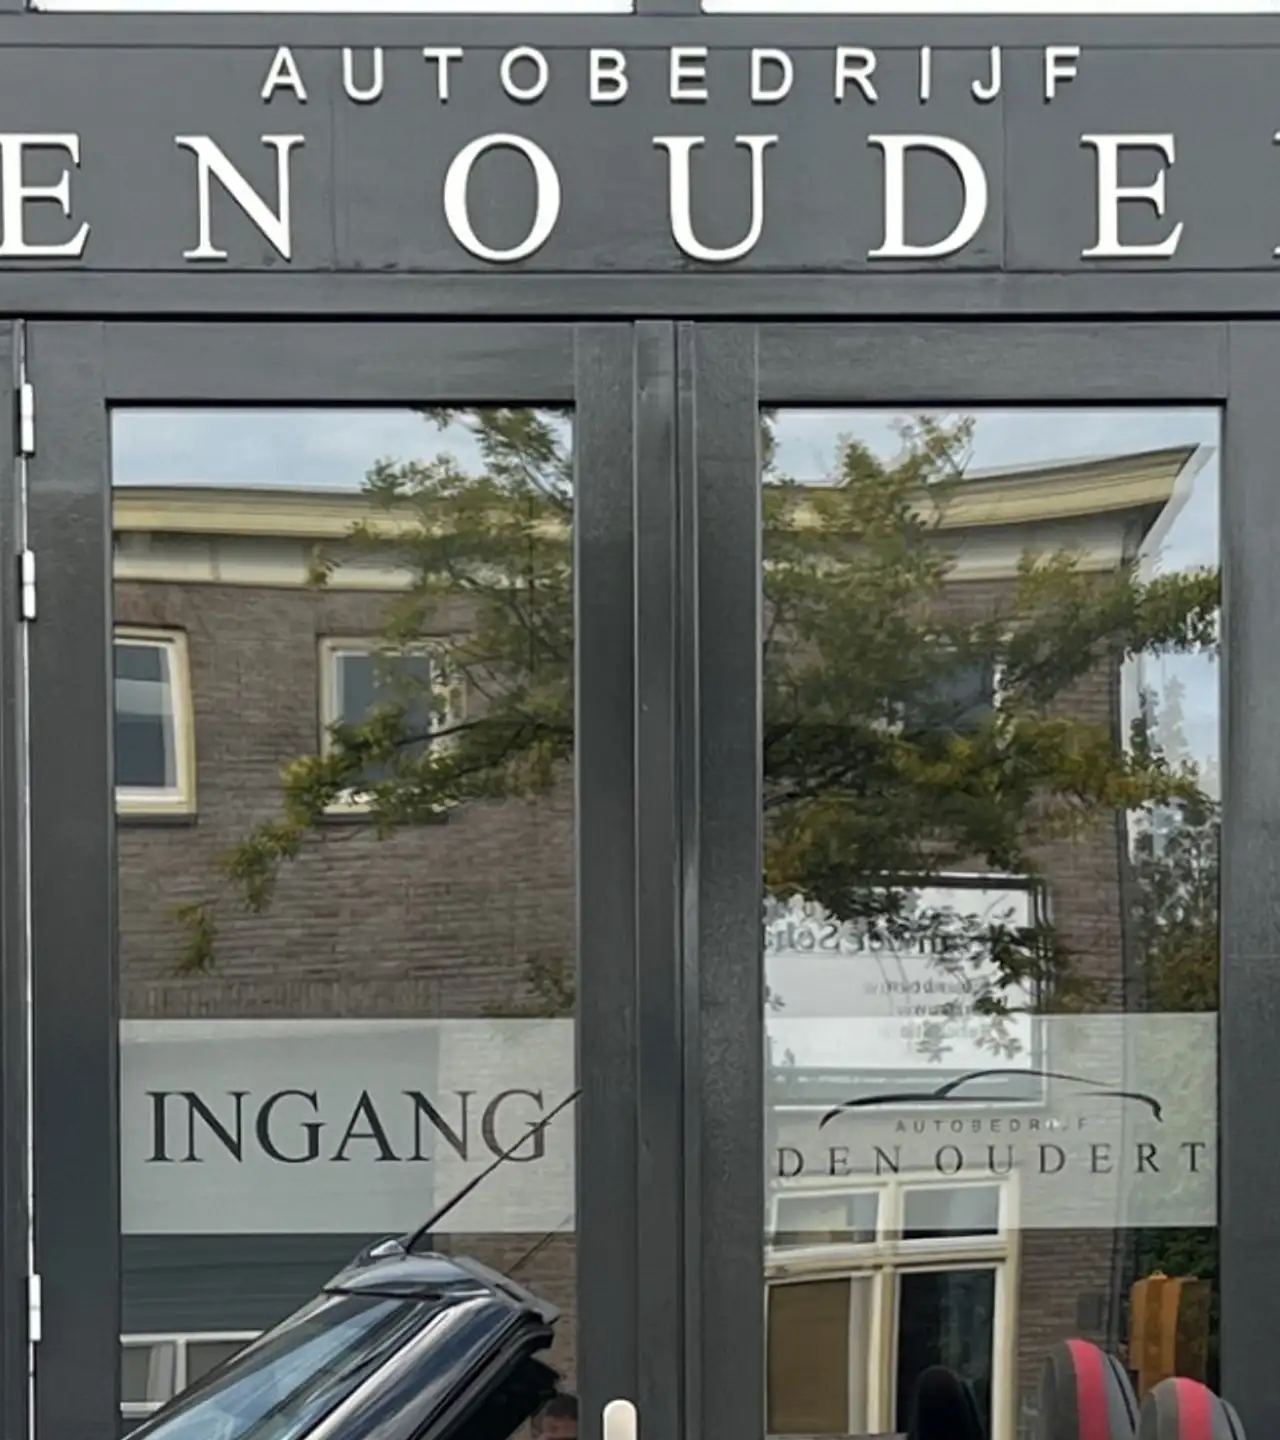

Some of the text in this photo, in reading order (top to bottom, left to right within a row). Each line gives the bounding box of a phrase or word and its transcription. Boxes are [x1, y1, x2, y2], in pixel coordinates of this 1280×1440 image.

[261, 46, 1081, 100] AUTOBEDRIJF
[147, 1088, 553, 1163] INGANG
[777, 1141, 1207, 1178] DEN OUDERT
